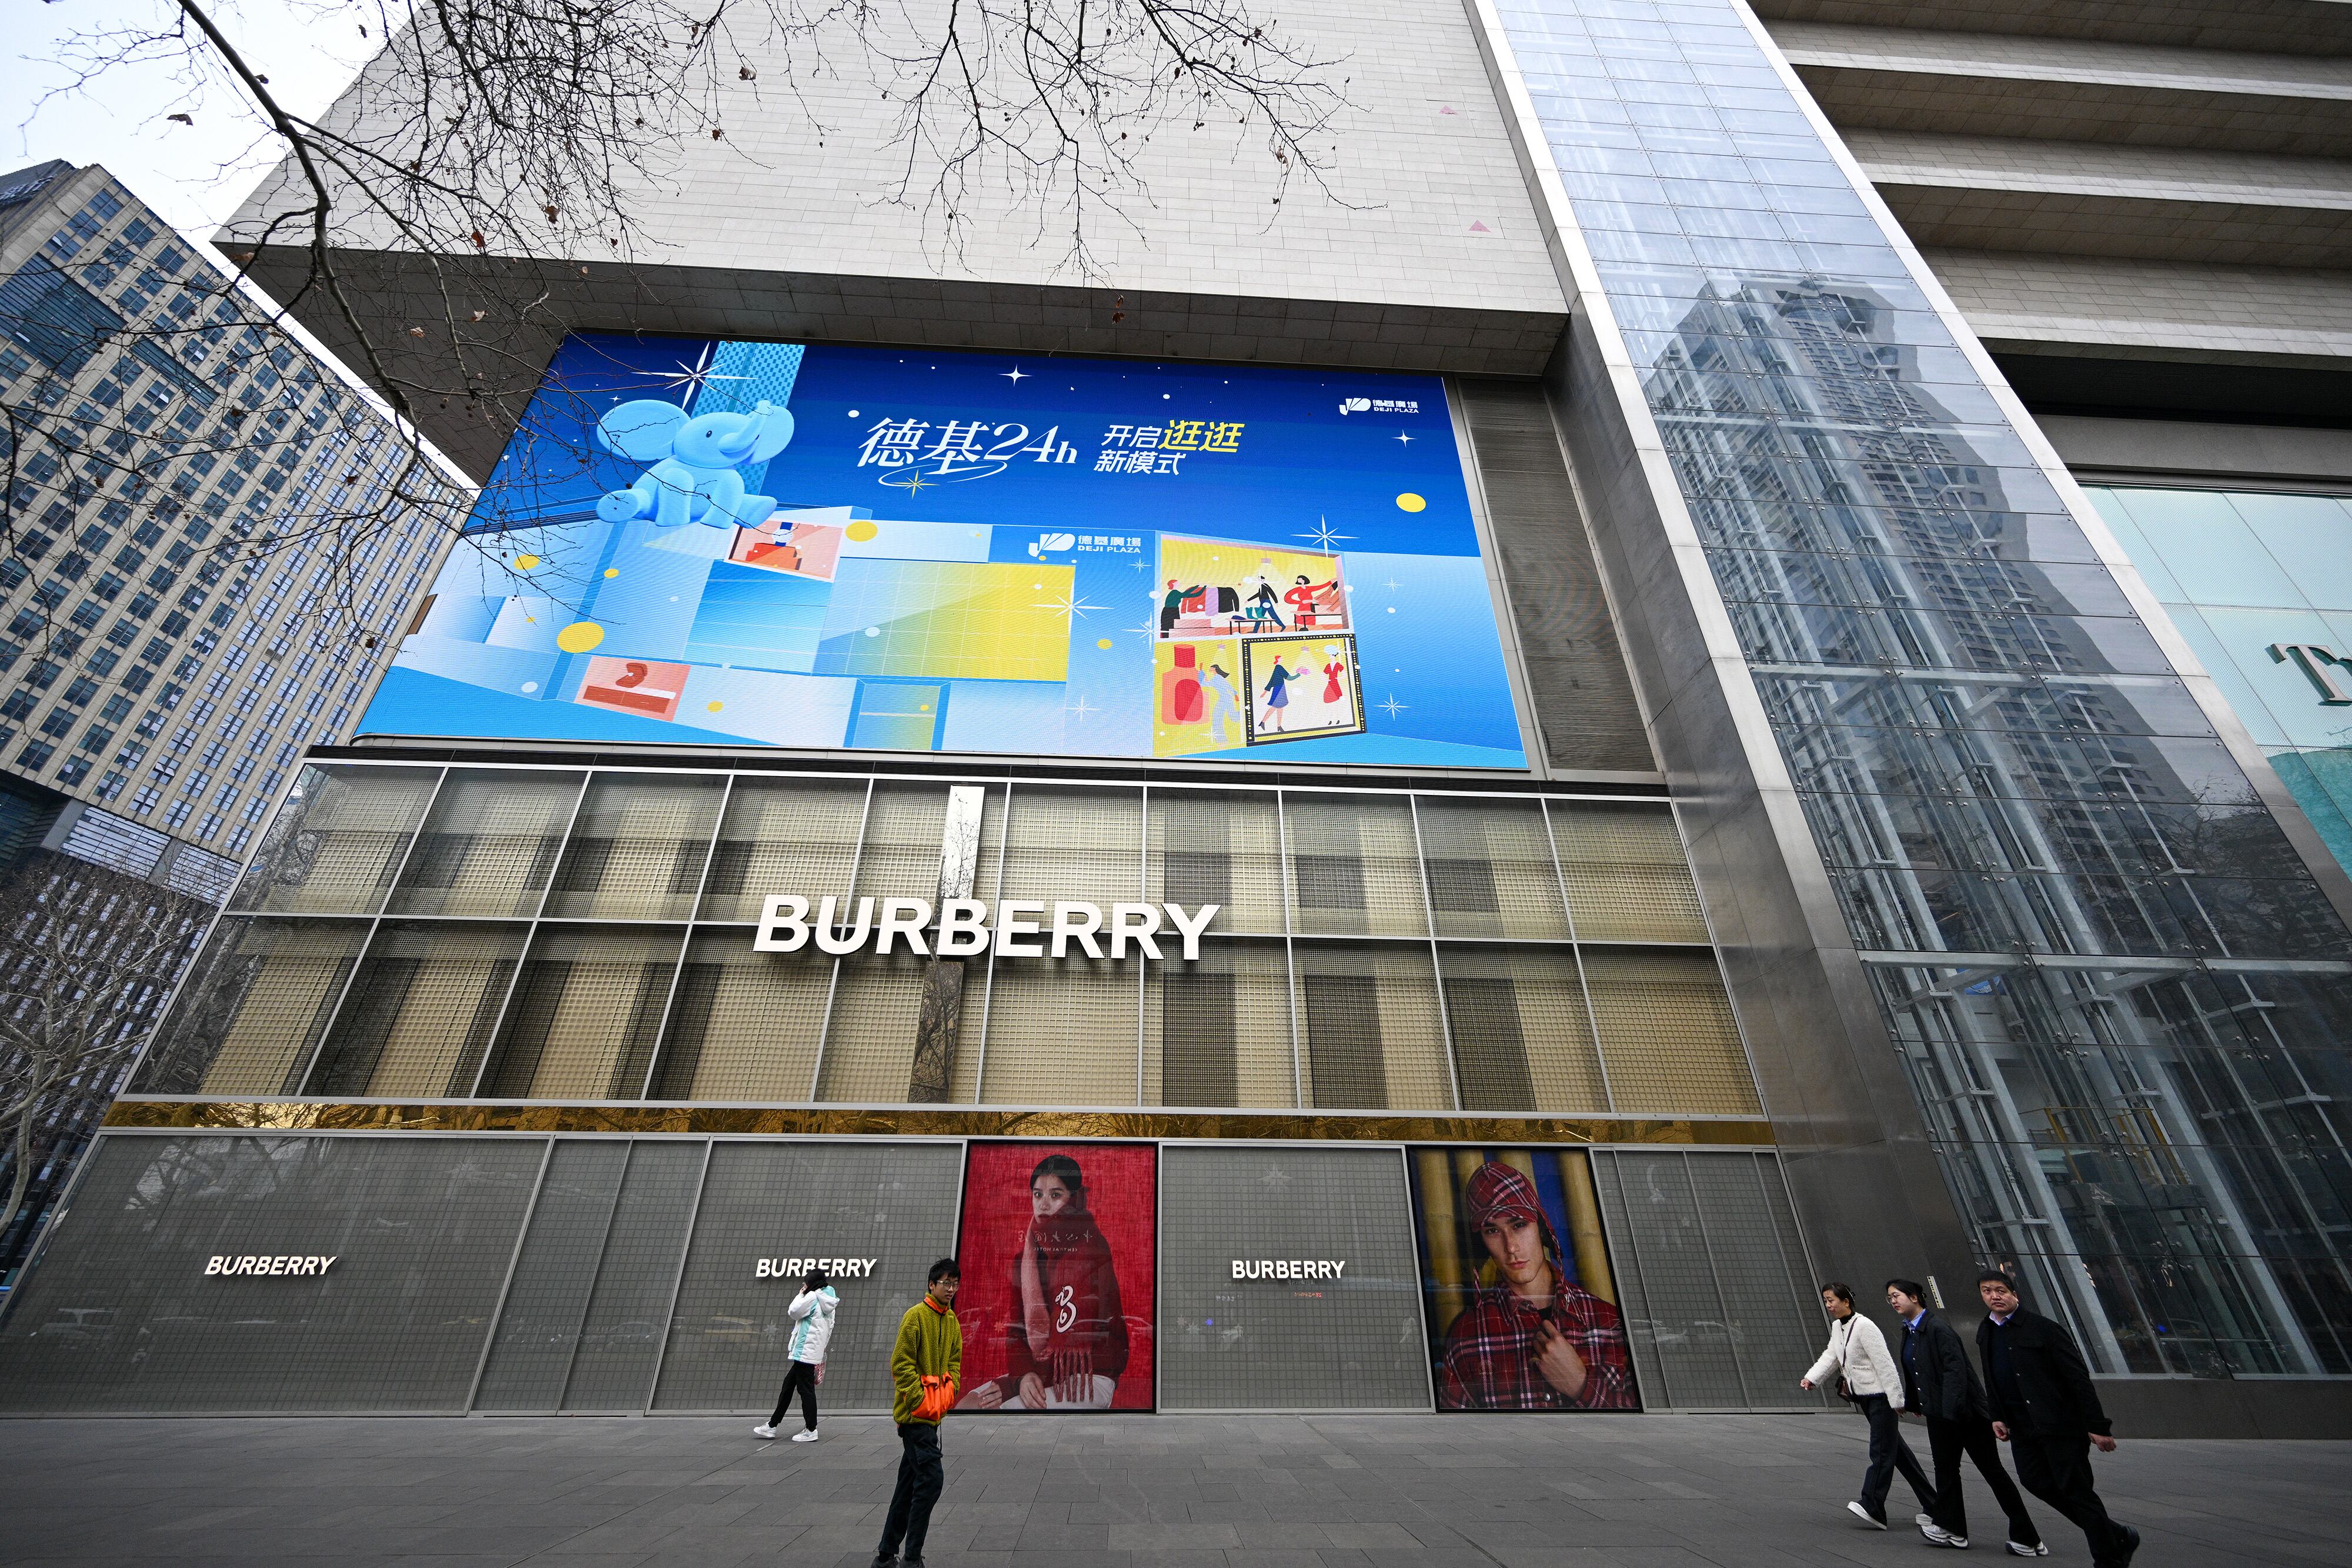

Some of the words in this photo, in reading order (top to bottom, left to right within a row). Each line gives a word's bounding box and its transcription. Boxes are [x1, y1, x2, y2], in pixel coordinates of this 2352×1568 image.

[1101, 419, 1245, 453] 开启逛逛
[1093, 449, 1187, 475] 新模式
[753, 894, 1221, 961] BURBERRY
[204, 1256, 338, 1275] BURBERRY
[756, 1258, 878, 1277] BURBERRY
[1232, 1260, 1345, 1279] BURBERRY
